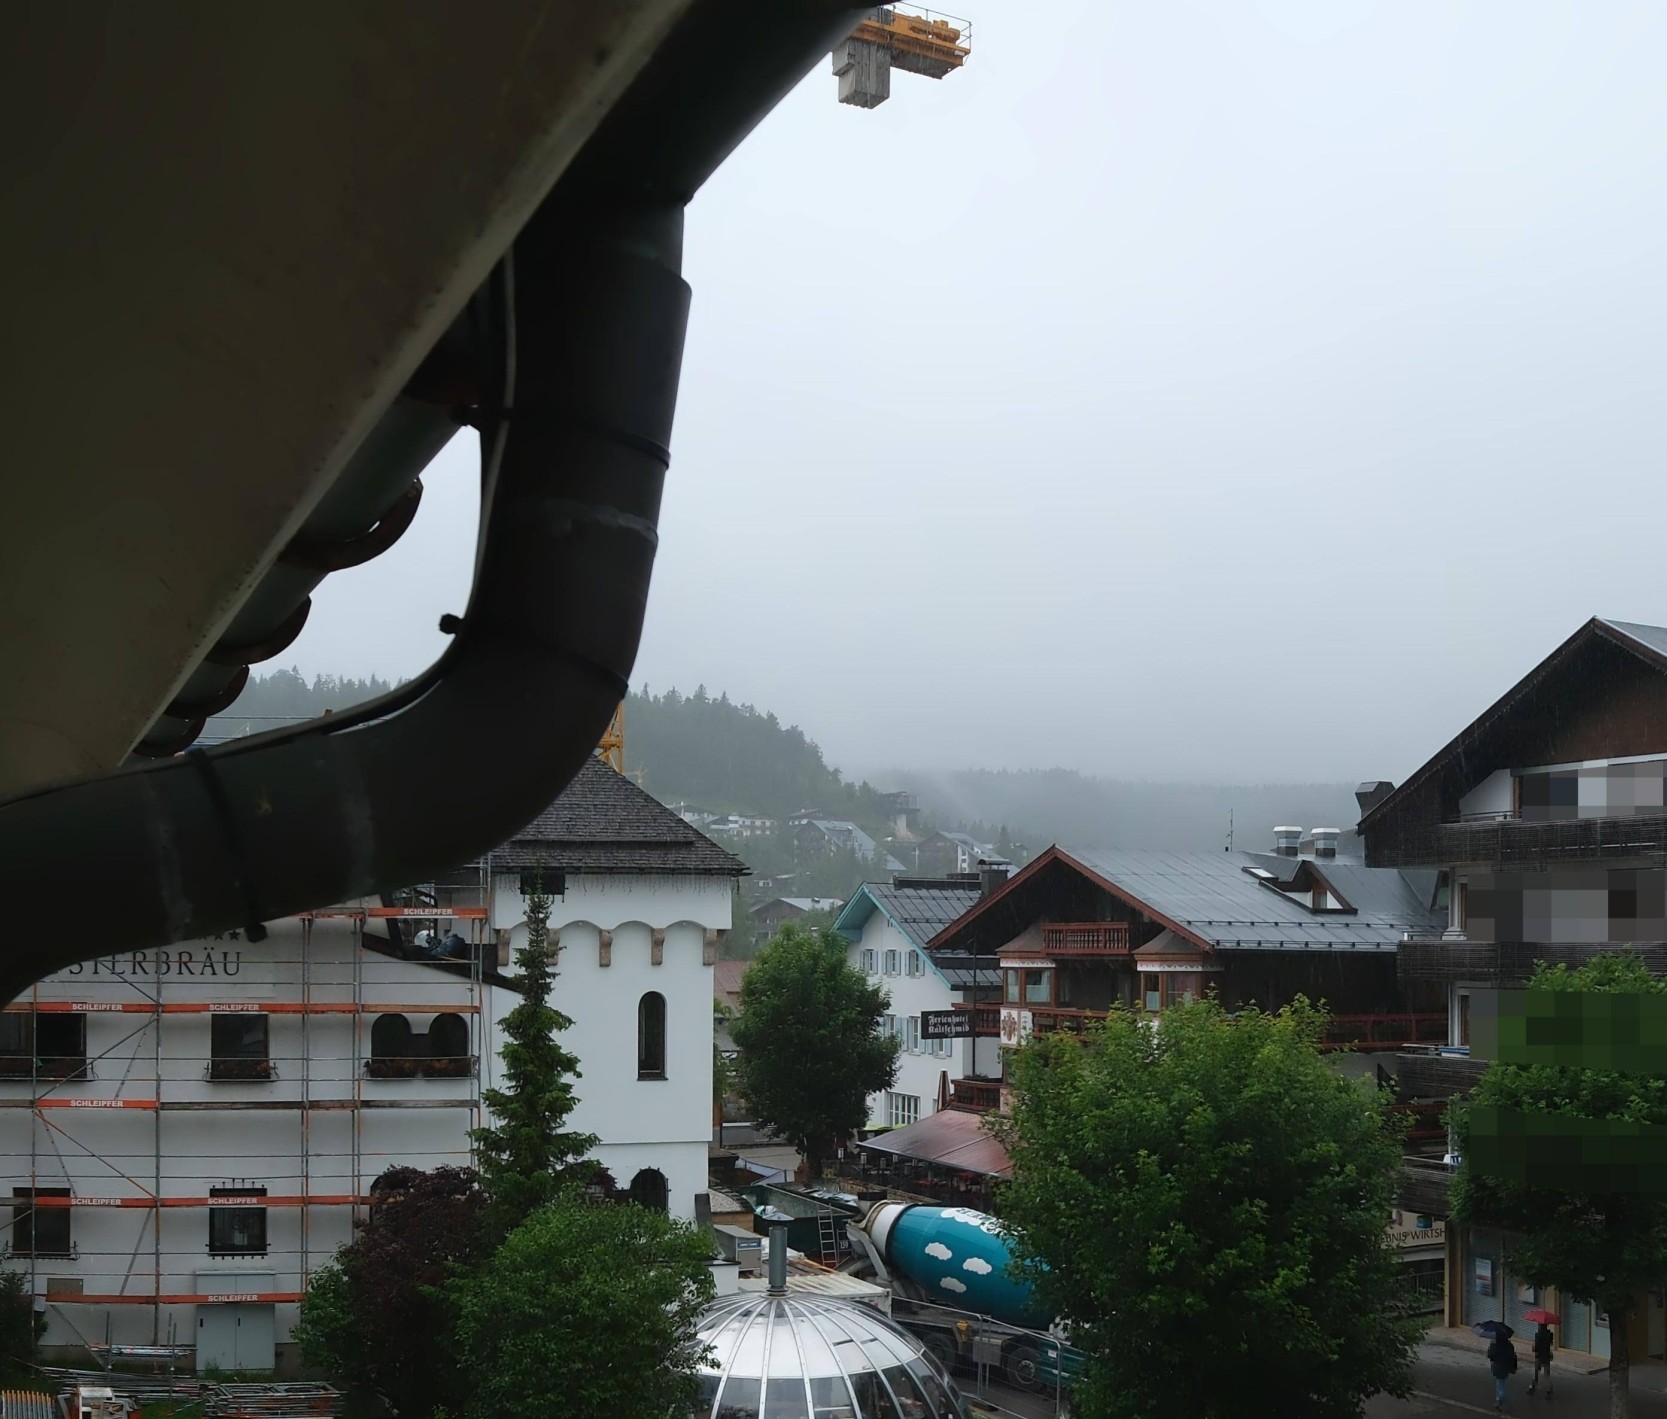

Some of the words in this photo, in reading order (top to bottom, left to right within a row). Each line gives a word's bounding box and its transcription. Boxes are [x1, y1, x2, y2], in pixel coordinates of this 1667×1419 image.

[403, 908, 453, 916] SCHLEIPFER
[72, 1003, 123, 1011] SCHLEIPFER
[209, 1003, 260, 1011] SCHLEIPFER
[71, 1100, 124, 1108] SCHLEIPFER
[71, 1198, 122, 1206] SCHLEIPFER
[207, 1197, 258, 1205] SCHLEIPFER
[207, 1294, 258, 1302] SCHLEIPFER
